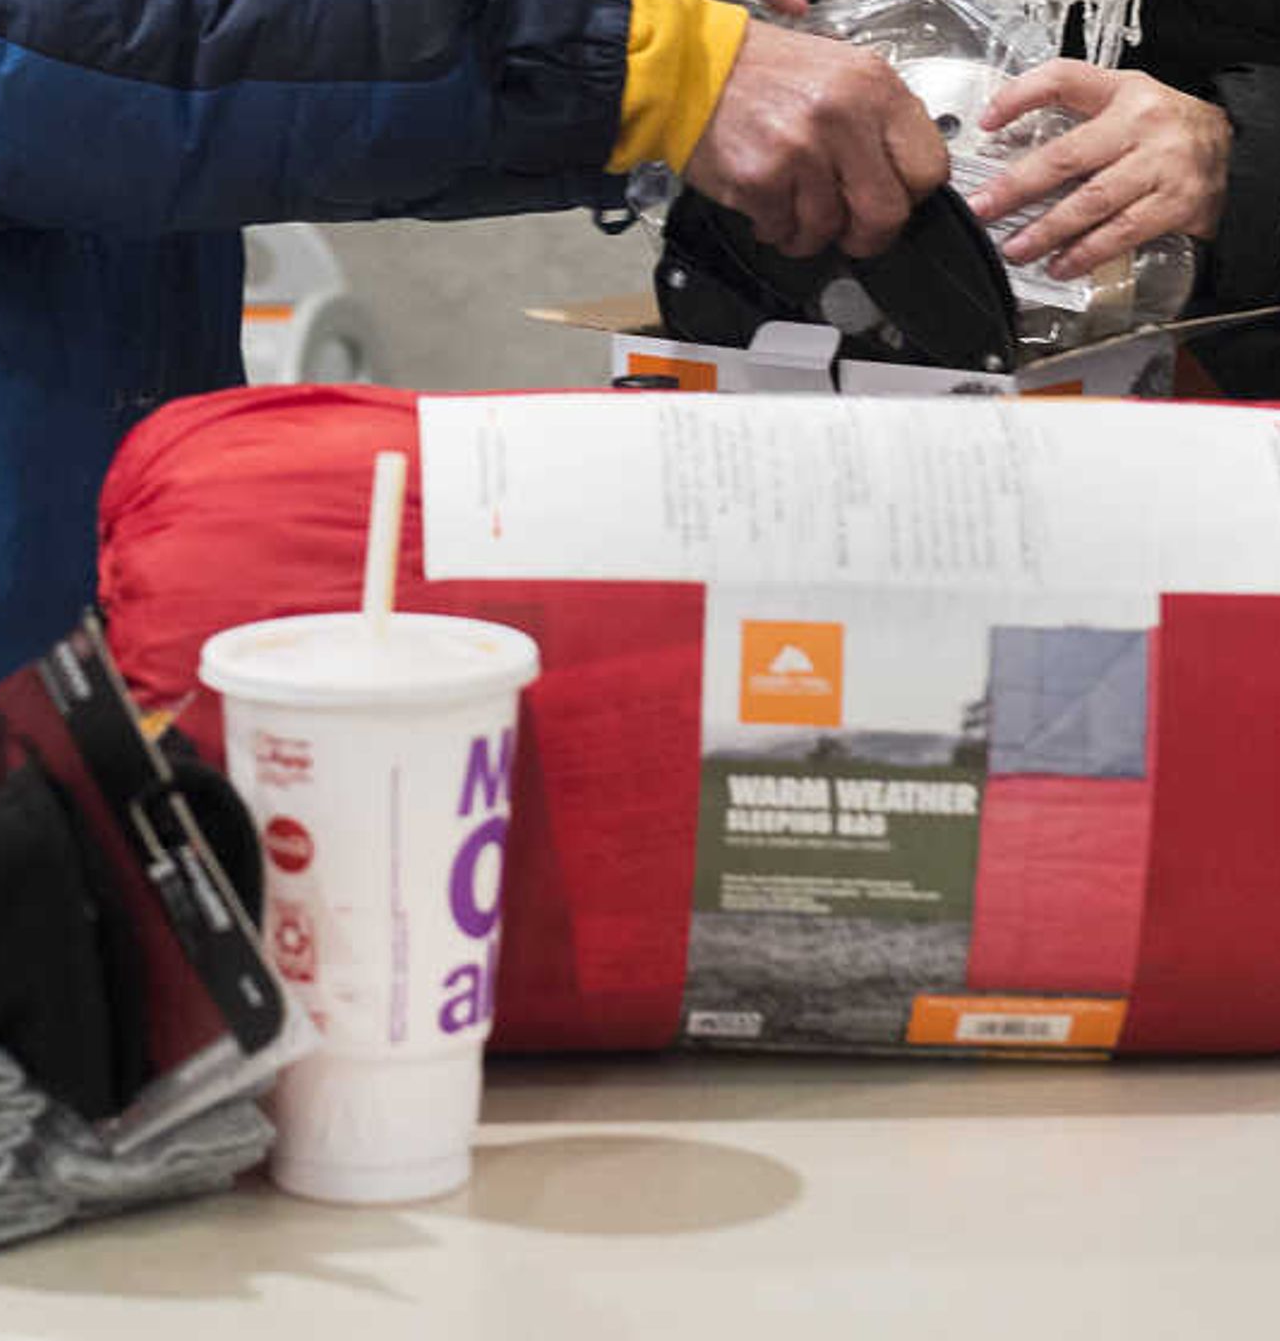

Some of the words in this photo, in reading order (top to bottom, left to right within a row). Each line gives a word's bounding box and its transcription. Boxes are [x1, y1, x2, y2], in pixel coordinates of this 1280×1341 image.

[726, 774, 831, 809] WARM
[835, 778, 979, 815] WEATHER
[726, 808, 833, 835] SLEEPING
[836, 812, 887, 837] BAG
